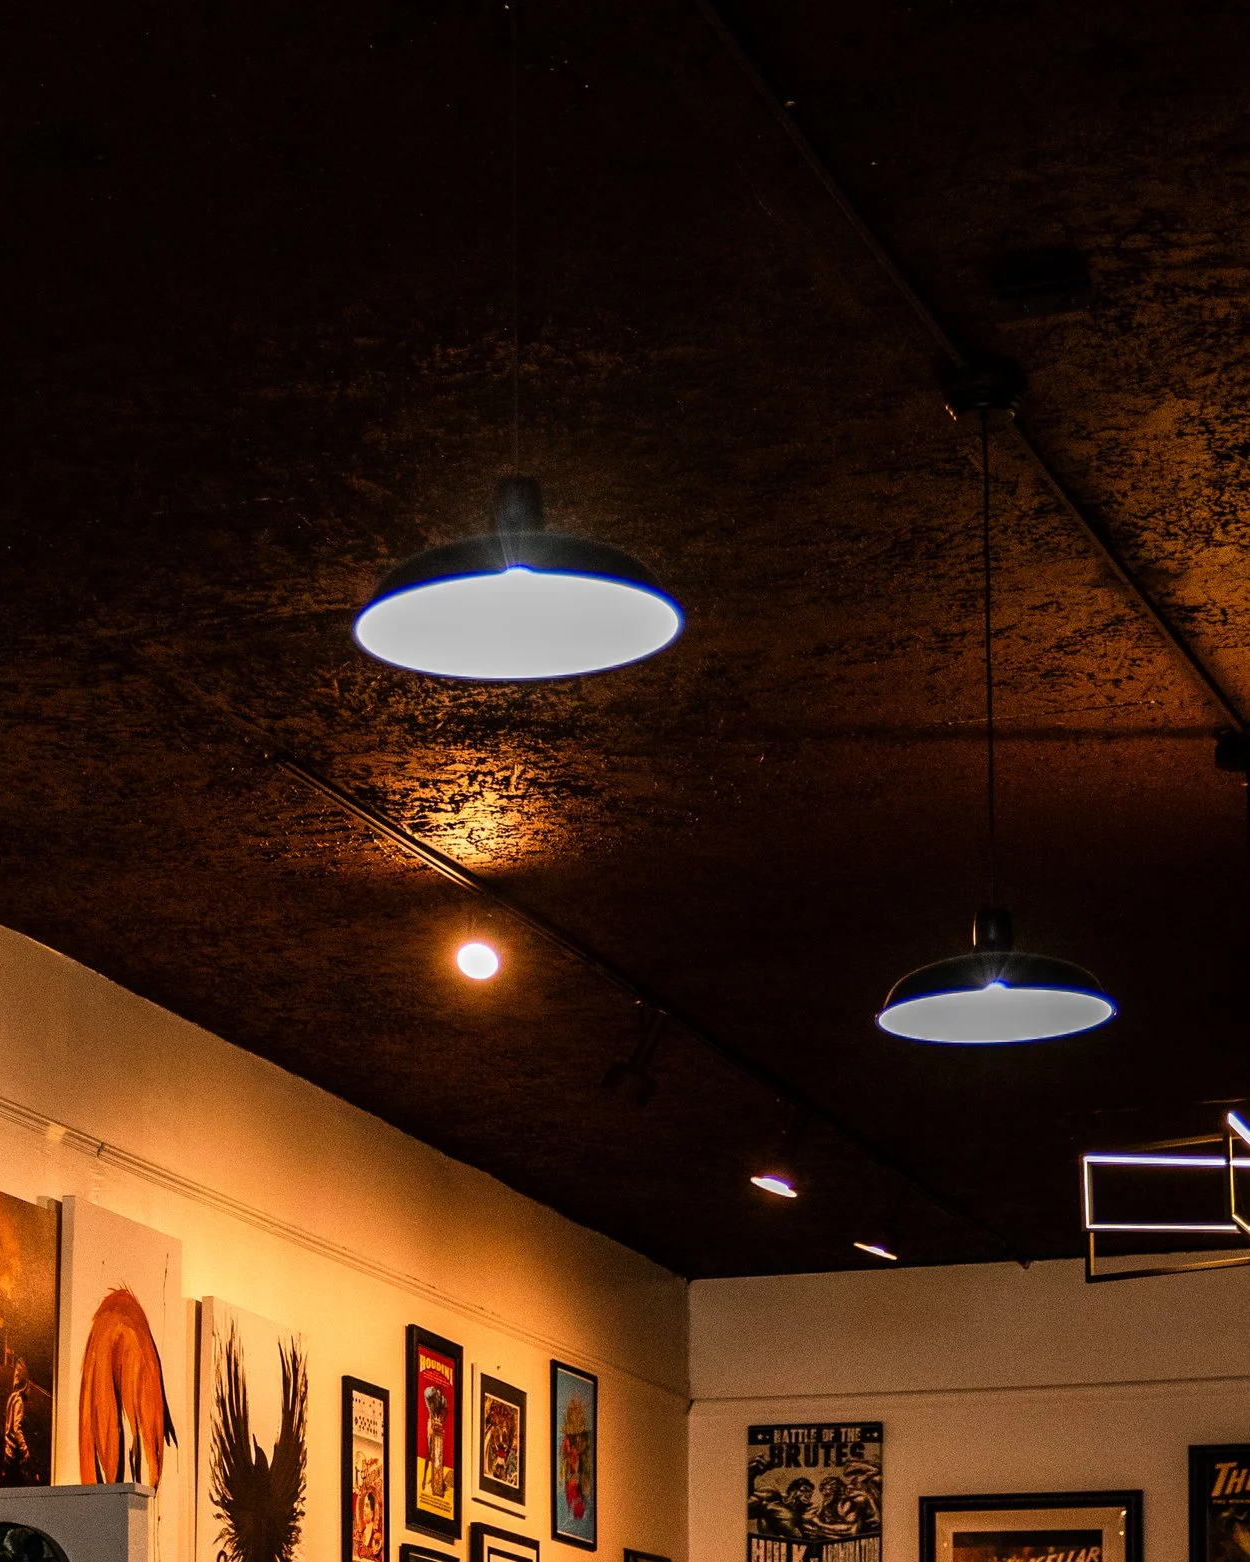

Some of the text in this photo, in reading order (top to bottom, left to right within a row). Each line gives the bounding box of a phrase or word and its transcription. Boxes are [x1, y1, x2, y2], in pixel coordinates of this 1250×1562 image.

[420, 1354, 453, 1386] HOUDINI
[774, 1428, 861, 1444] BATTLE OF THE
[769, 1443, 866, 1468] BRUTES
[1211, 1461, 1250, 1497] TH
